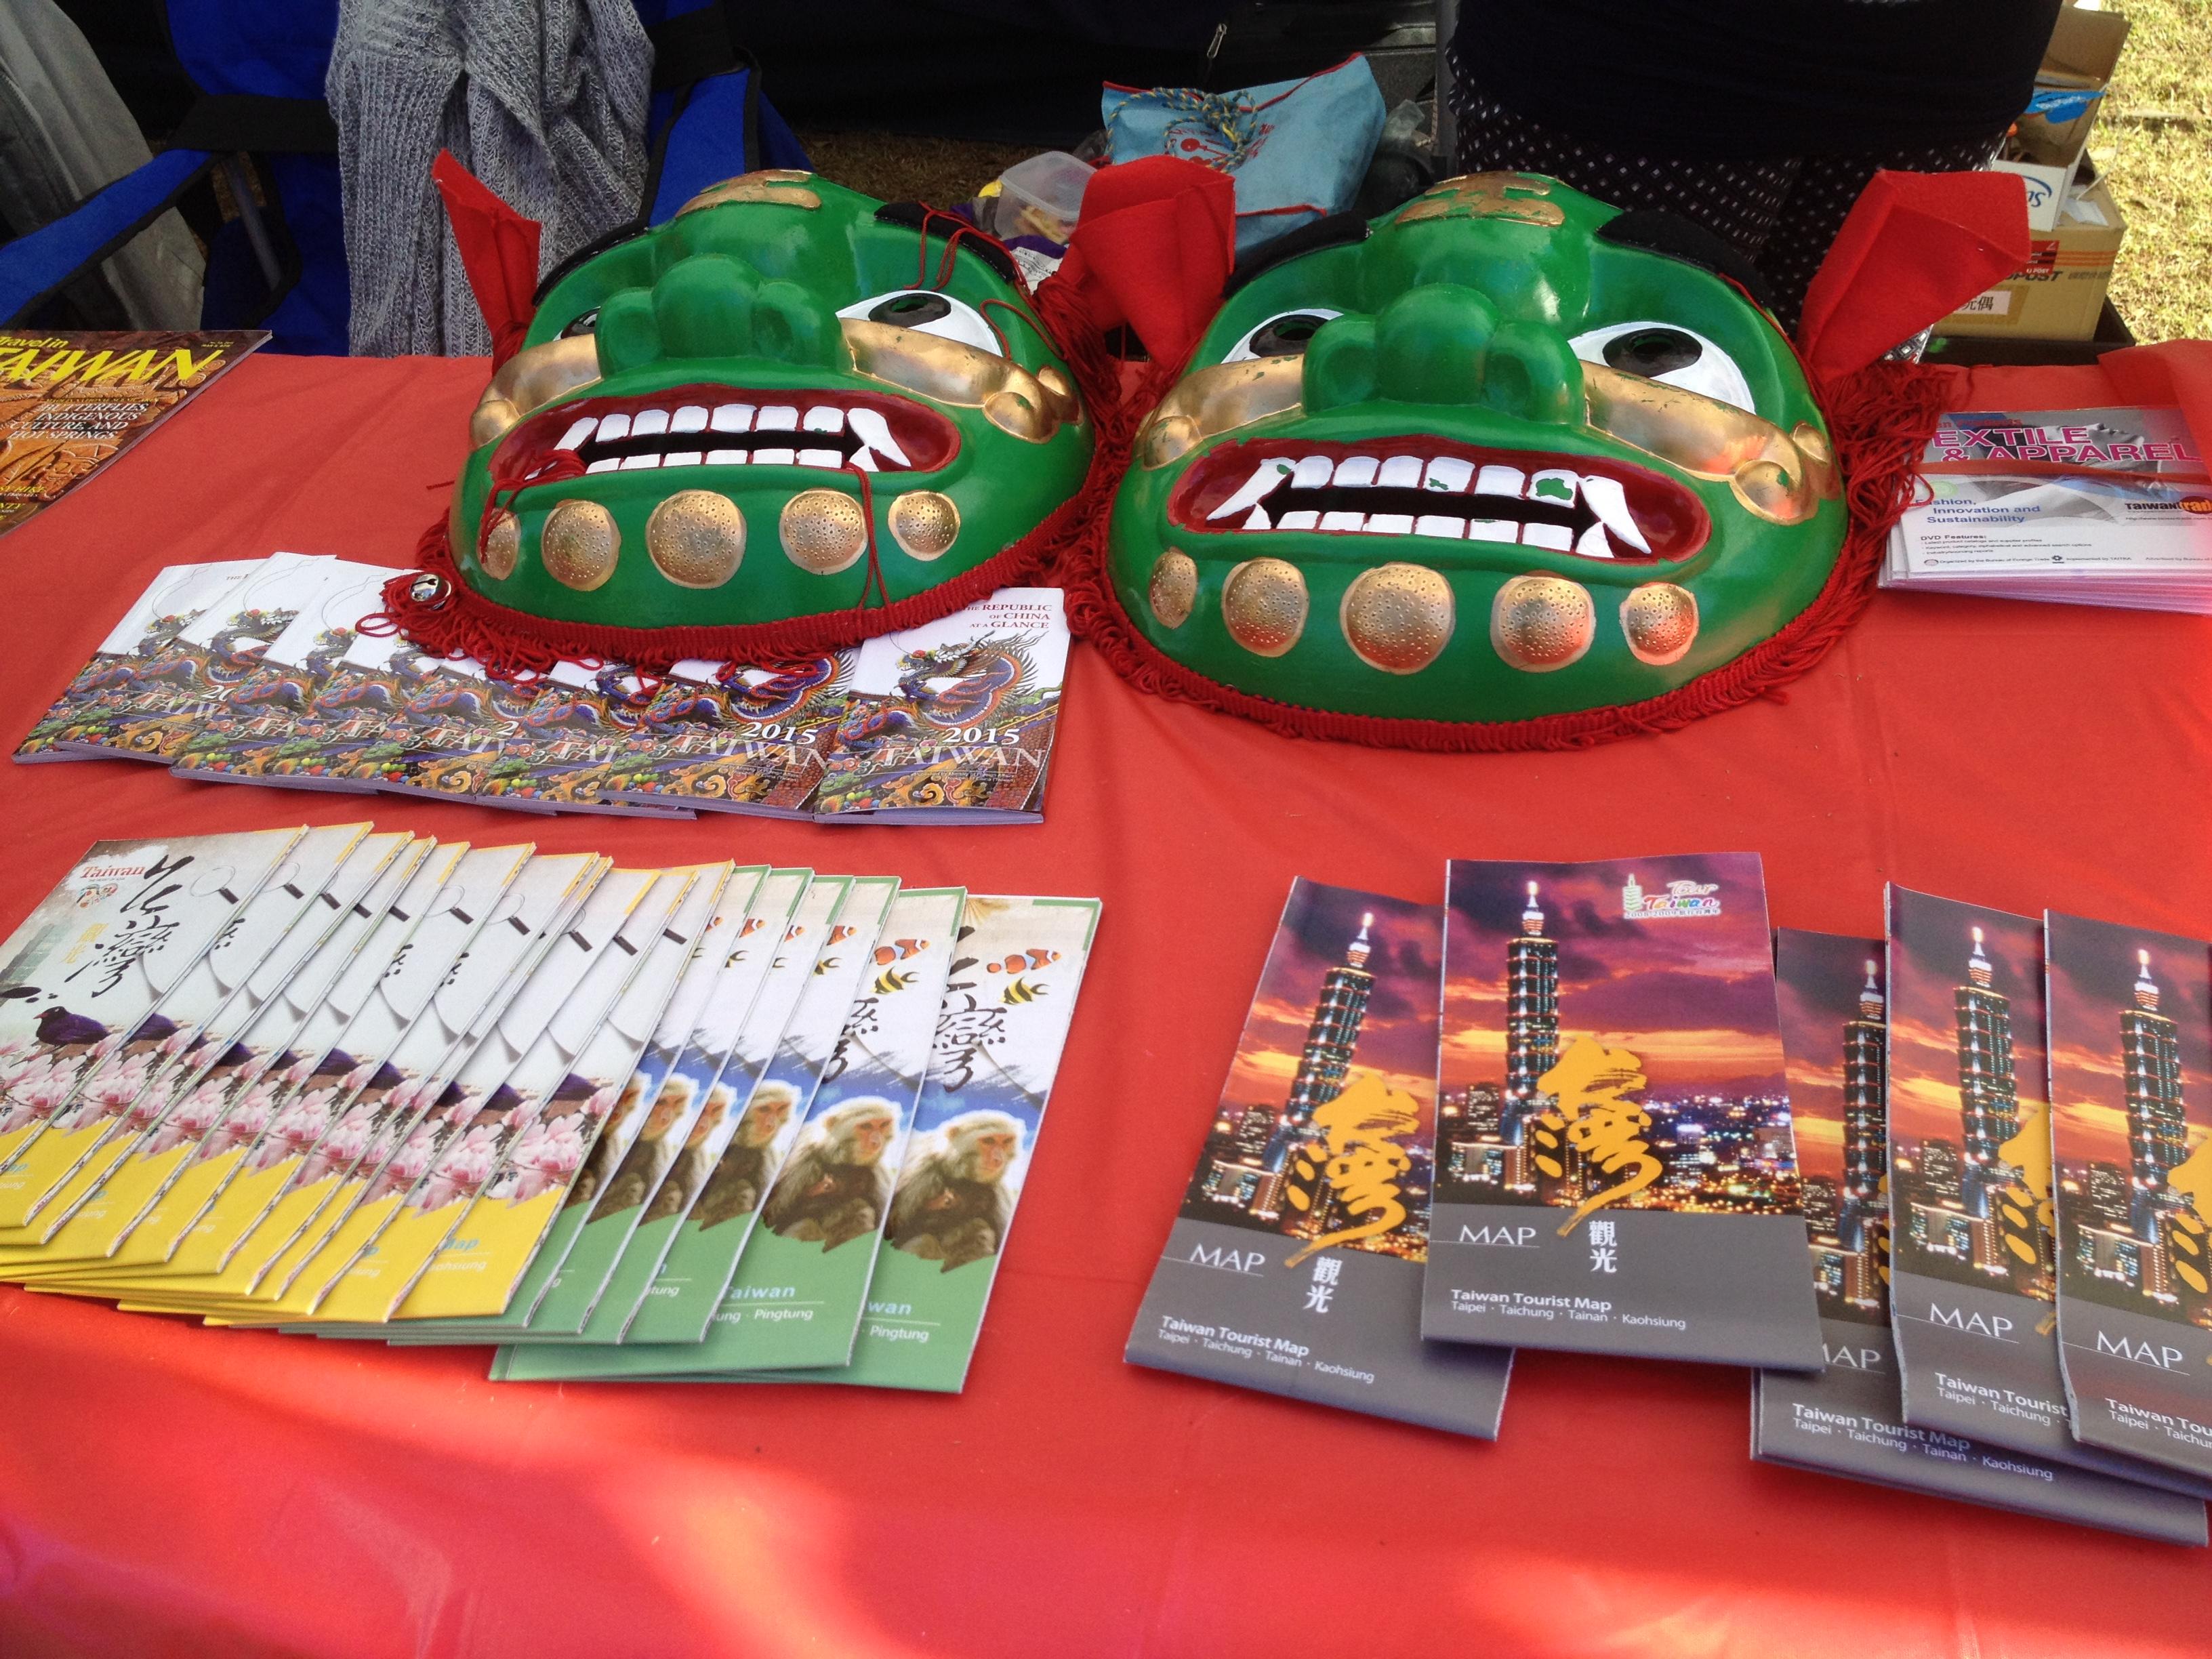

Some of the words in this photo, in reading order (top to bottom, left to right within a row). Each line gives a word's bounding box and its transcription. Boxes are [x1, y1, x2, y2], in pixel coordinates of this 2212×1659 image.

[35, 412, 141, 421] INDIGENOUS
[39, 403, 148, 412] BUTTERFLIES,
[9, 431, 48, 439] HOT
[45, 431, 119, 440] SPRINGS
[10, 422, 85, 431] CULTURE,
[88, 422, 129, 430] AND
[1932, 427, 2093, 448] EXTILE
[1941, 448, 1970, 462] &
[1986, 443, 2203, 463] APPAREL
[1927, 515, 2025, 524] Sustainability
[1933, 507, 2009, 515] Innovation
[741, 722, 819, 745] 2015
[943, 727, 1021, 745] 2015
[673, 734, 835, 769] TAIWAN
[879, 745, 1046, 768] TAIWAN
[81, 865, 145, 878] Taiwan
[1666, 880, 1719, 895] Tour
[1643, 895, 1721, 910] Taiwan
[1459, 1225, 1536, 1245] MAP
[1189, 1243, 1265, 1271] MAP
[1589, 1221, 1618, 1273] 觀光
[727, 1286, 796, 1300] aiwan
[1303, 1256, 1343, 1313] 觀光
[1452, 1289, 1509, 1303] Taiwan
[1513, 1292, 1571, 1308] Tourist
[1574, 1297, 1612, 1313] Map
[754, 1309, 814, 1322] Pingtung
[1452, 1301, 1486, 1313] Taipei
[1500, 1304, 1554, 1320] Taichung
[1568, 1309, 1607, 1322] Tainan
[1622, 1314, 1686, 1330] Kaohsiung
[1929, 1303, 2013, 1337] MAP
[870, 1324, 929, 1343] Pingtung
[1162, 1315, 1215, 1336] Taiwan
[1220, 1326, 1272, 1348] Tourist
[1273, 1338, 1309, 1357] Map
[1158, 1328, 1191, 1344] Taipei
[1202, 1338, 1252, 1358] Taichung
[1265, 1350, 1302, 1367] Tainan
[1314, 1361, 1374, 1383] Kaohsiung
[2097, 1330, 2183, 1368] MAP
[1935, 1372, 2000, 1399] Taiwan
[2003, 1389, 2068, 1416] Tourist
[1936, 1387, 1975, 1405] Taipei
[1990, 1400, 2051, 1427] Taichung
[2105, 1397, 2174, 1425] Taiwan
[2176, 1417, 2212, 1436] Tou
[1792, 1403, 1858, 1427] Taiwan
[1861, 1416, 1925, 1441] Tourist
[1929, 1431, 1971, 1451] Map
[2108, 1410, 2149, 1430] Taipei
[1793, 1417, 1832, 1435] Taipei
[1846, 1429, 1907, 1452] Taichung
[1923, 1443, 1967, 1462] Tainan
[1982, 1456, 2053, 1481] Kaohsiung
